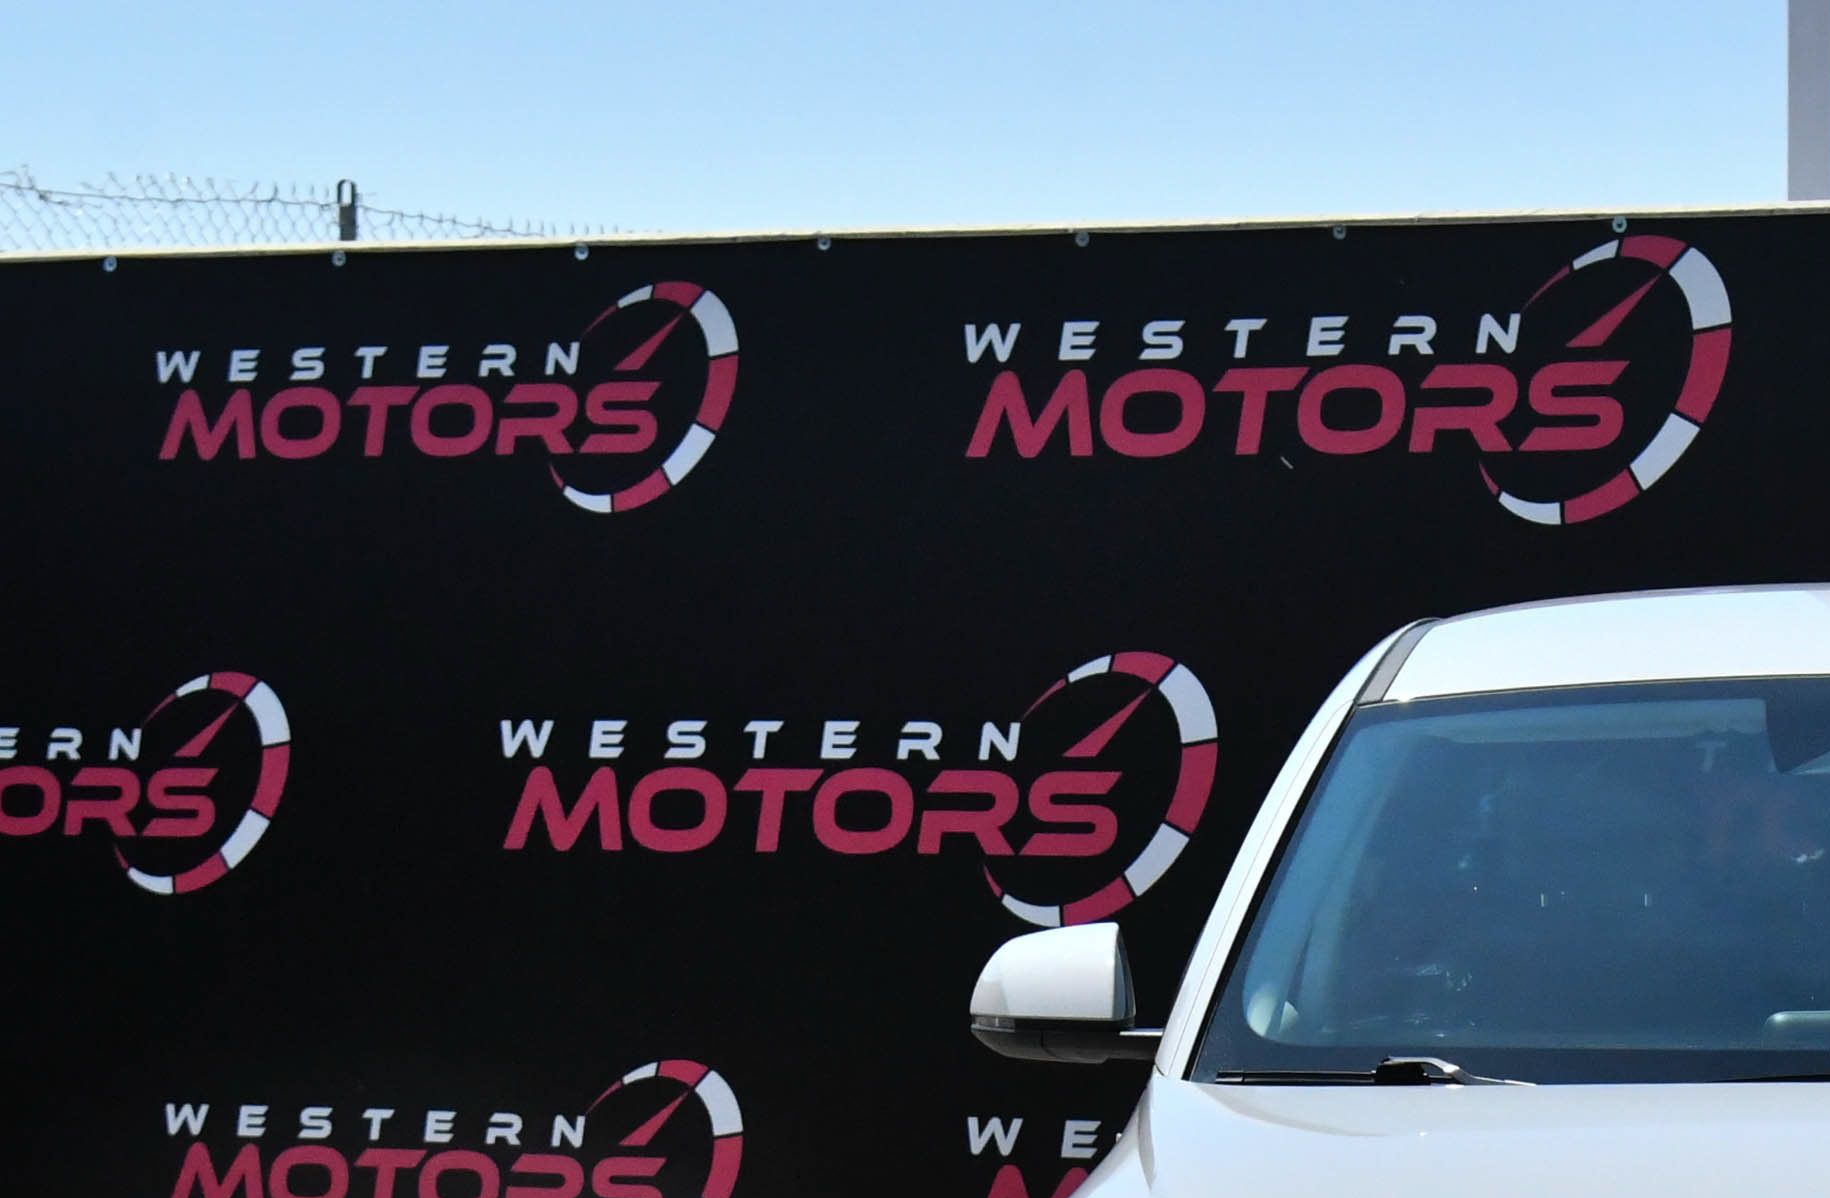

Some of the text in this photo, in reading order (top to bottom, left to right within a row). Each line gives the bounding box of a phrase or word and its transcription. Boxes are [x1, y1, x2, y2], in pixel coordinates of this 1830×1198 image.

[965, 313, 1521, 363] WESTERN
[157, 342, 580, 383] WESTERN
[162, 381, 657, 459] MOTORS
[967, 361, 1626, 457] MOTORS
[501, 719, 1021, 761] WESTERN
[504, 766, 1120, 856] MOTORS
[166, 1103, 586, 1148] WESTERN
[967, 1115, 1122, 1159] WE
